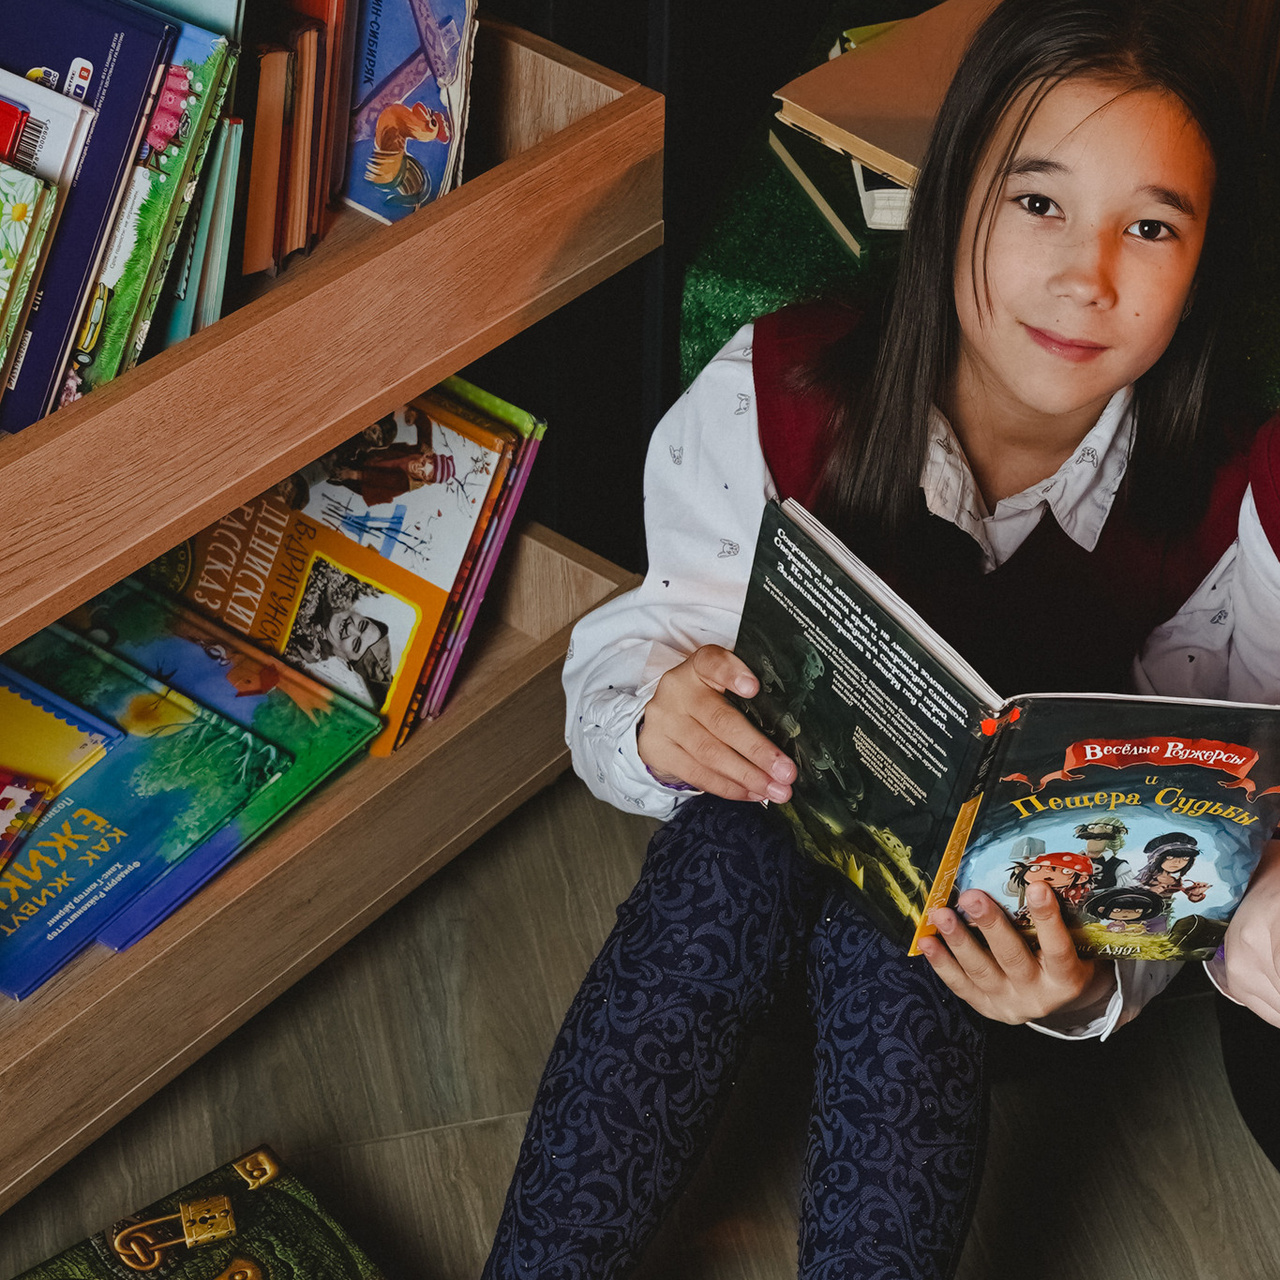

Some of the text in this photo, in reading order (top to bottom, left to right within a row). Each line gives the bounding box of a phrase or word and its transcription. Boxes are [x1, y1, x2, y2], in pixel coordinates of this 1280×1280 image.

[790, 563, 802, 580] Но
[844, 618, 877, 654] ведьмам
[813, 577, 848, 614] слишком
[878, 639, 927, 689] старомодно
[823, 574, 833, 585] не
[833, 586, 861, 614] любим
[879, 629, 890, 641] не
[890, 641, 918, 670] любим
[828, 615, 863, 652] пиратов
[872, 658, 901, 690] пещеру
[902, 687, 917, 705] под
[1083, 741, 1248, 765] Весёлые Роджерсы
[1145, 775, 1158, 785] и
[1009, 786, 1260, 827] Пещера Судьбы
[0, 808, 111, 910] ЁЖИК
[0, 827, 128, 937] КАК ЖИВУТ
[103, 860, 142, 894] Фридерун
[1098, 943, 1142, 955] Дудл
